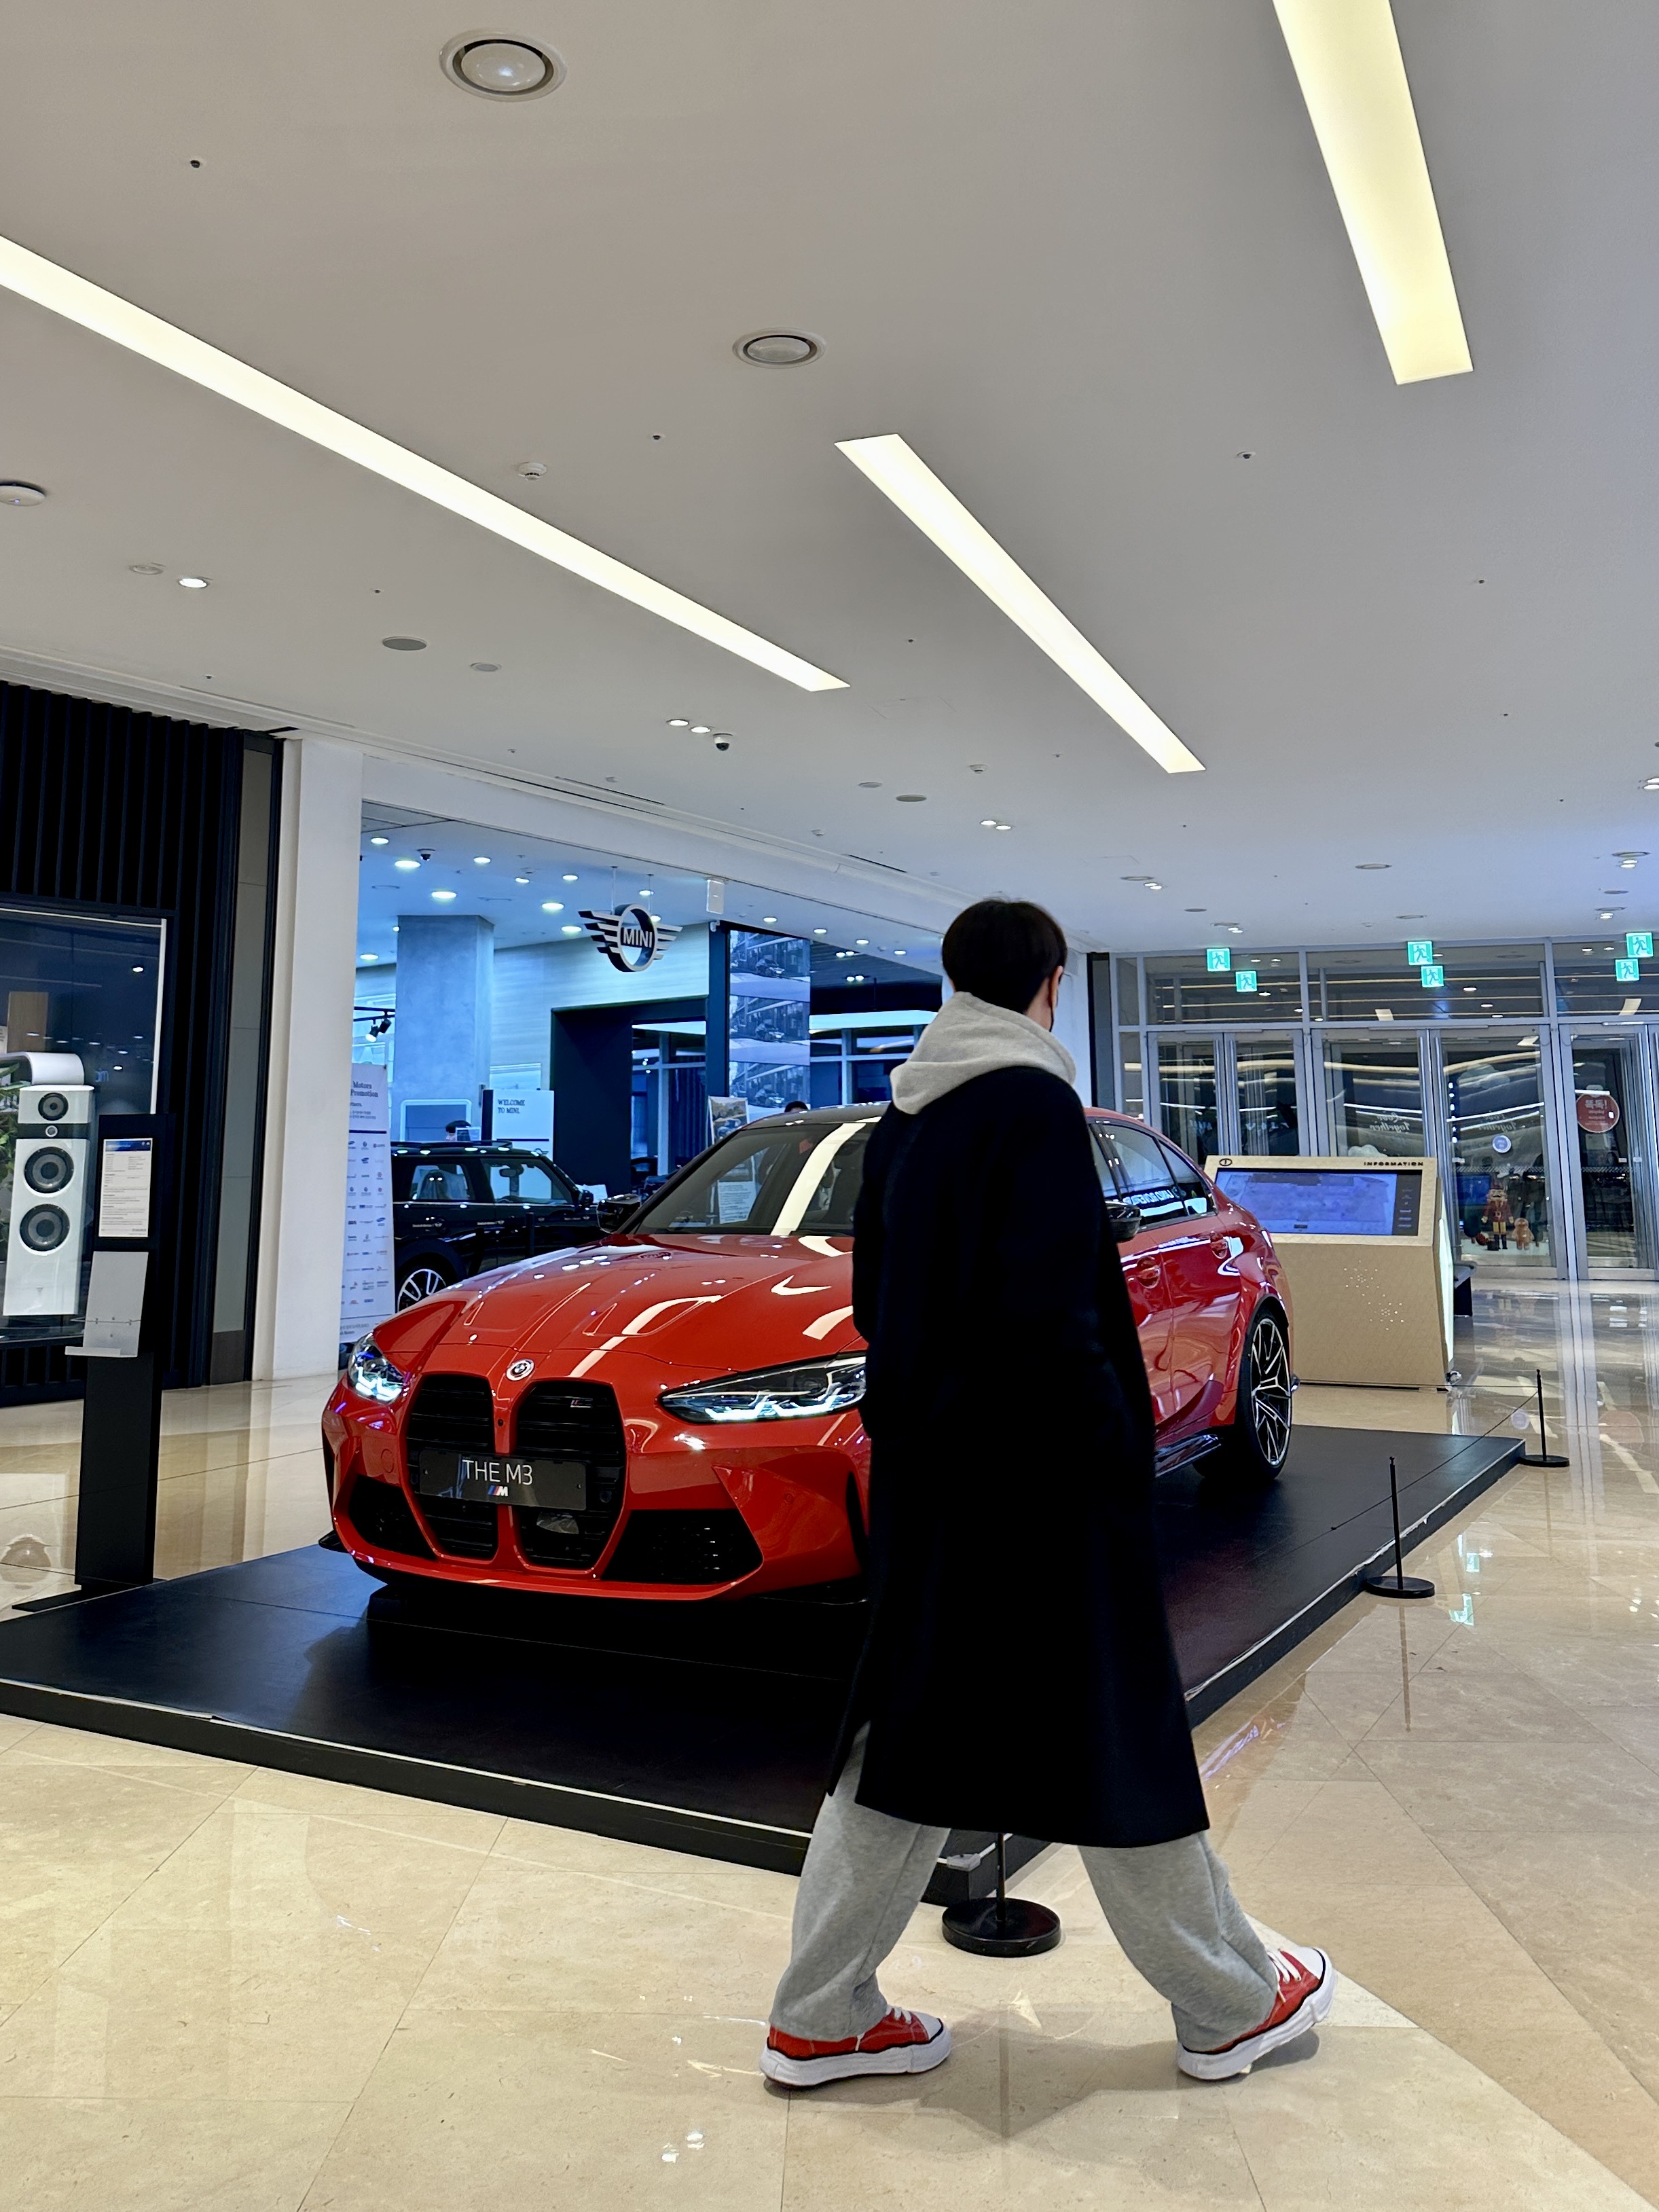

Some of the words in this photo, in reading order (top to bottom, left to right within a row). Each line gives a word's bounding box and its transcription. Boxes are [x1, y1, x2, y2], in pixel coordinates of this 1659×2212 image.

[623, 928, 653, 948] MINI
[350, 1089, 379, 1098] Promotion
[462, 1459, 500, 1483] THE
[506, 1463, 533, 1485] M3
